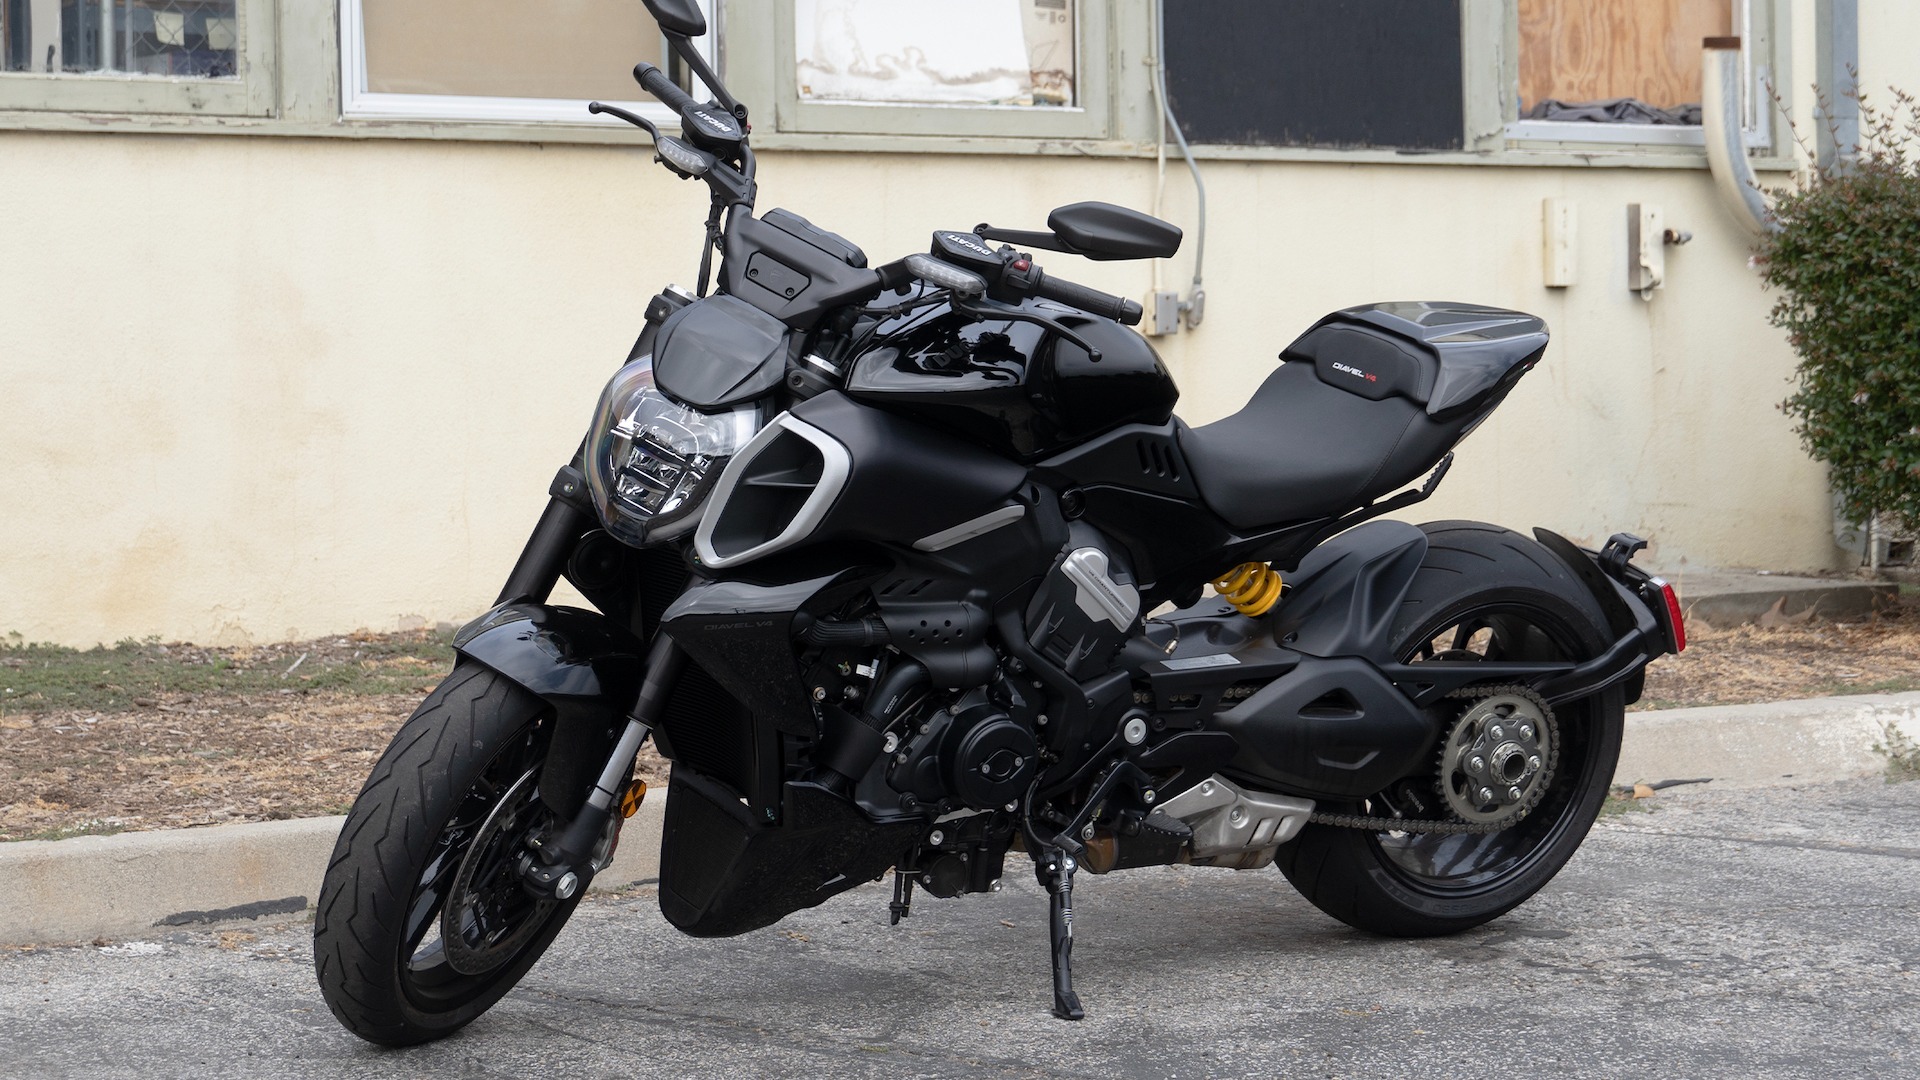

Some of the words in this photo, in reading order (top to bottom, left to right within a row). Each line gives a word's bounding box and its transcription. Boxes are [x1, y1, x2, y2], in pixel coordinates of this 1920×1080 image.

[694, 111, 732, 132] DUCATI
[947, 234, 992, 256] DUCATI
[1332, 361, 1365, 378] DIAVEL
[1365, 372, 1377, 382] V4
[704, 622, 755, 631] DIAVEL
